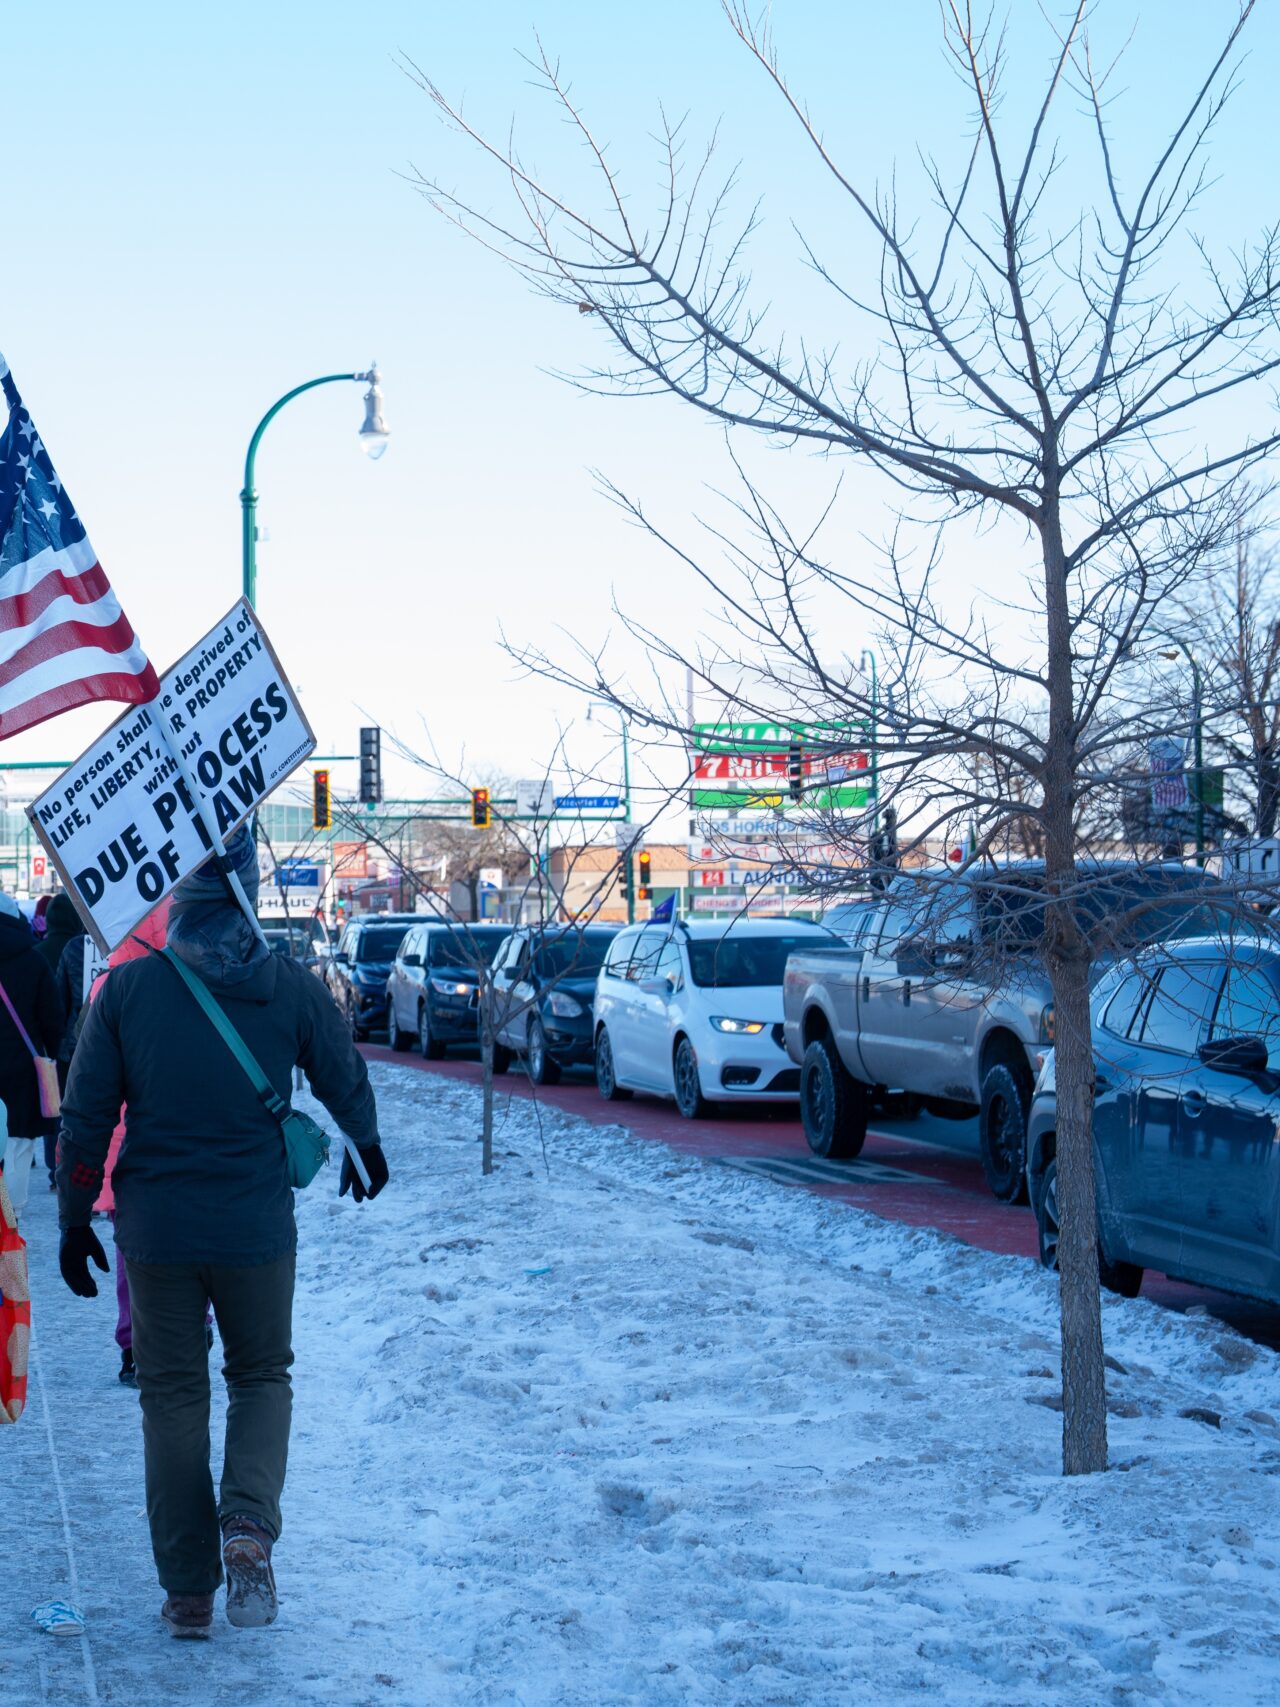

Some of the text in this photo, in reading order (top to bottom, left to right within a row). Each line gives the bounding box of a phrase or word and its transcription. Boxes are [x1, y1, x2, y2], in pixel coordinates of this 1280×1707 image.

[49, 807, 92, 849] LIFE,
[89, 740, 161, 811] LIBERTY,
[185, 631, 262, 719] PROPERTY
[64, 750, 115, 806] person
[116, 708, 153, 754] shall
[174, 626, 235, 696] deprived
[236, 608, 252, 633] of
[703, 757, 723, 778] 7
[73, 822, 149, 909] DUE
[136, 838, 181, 903] OF
